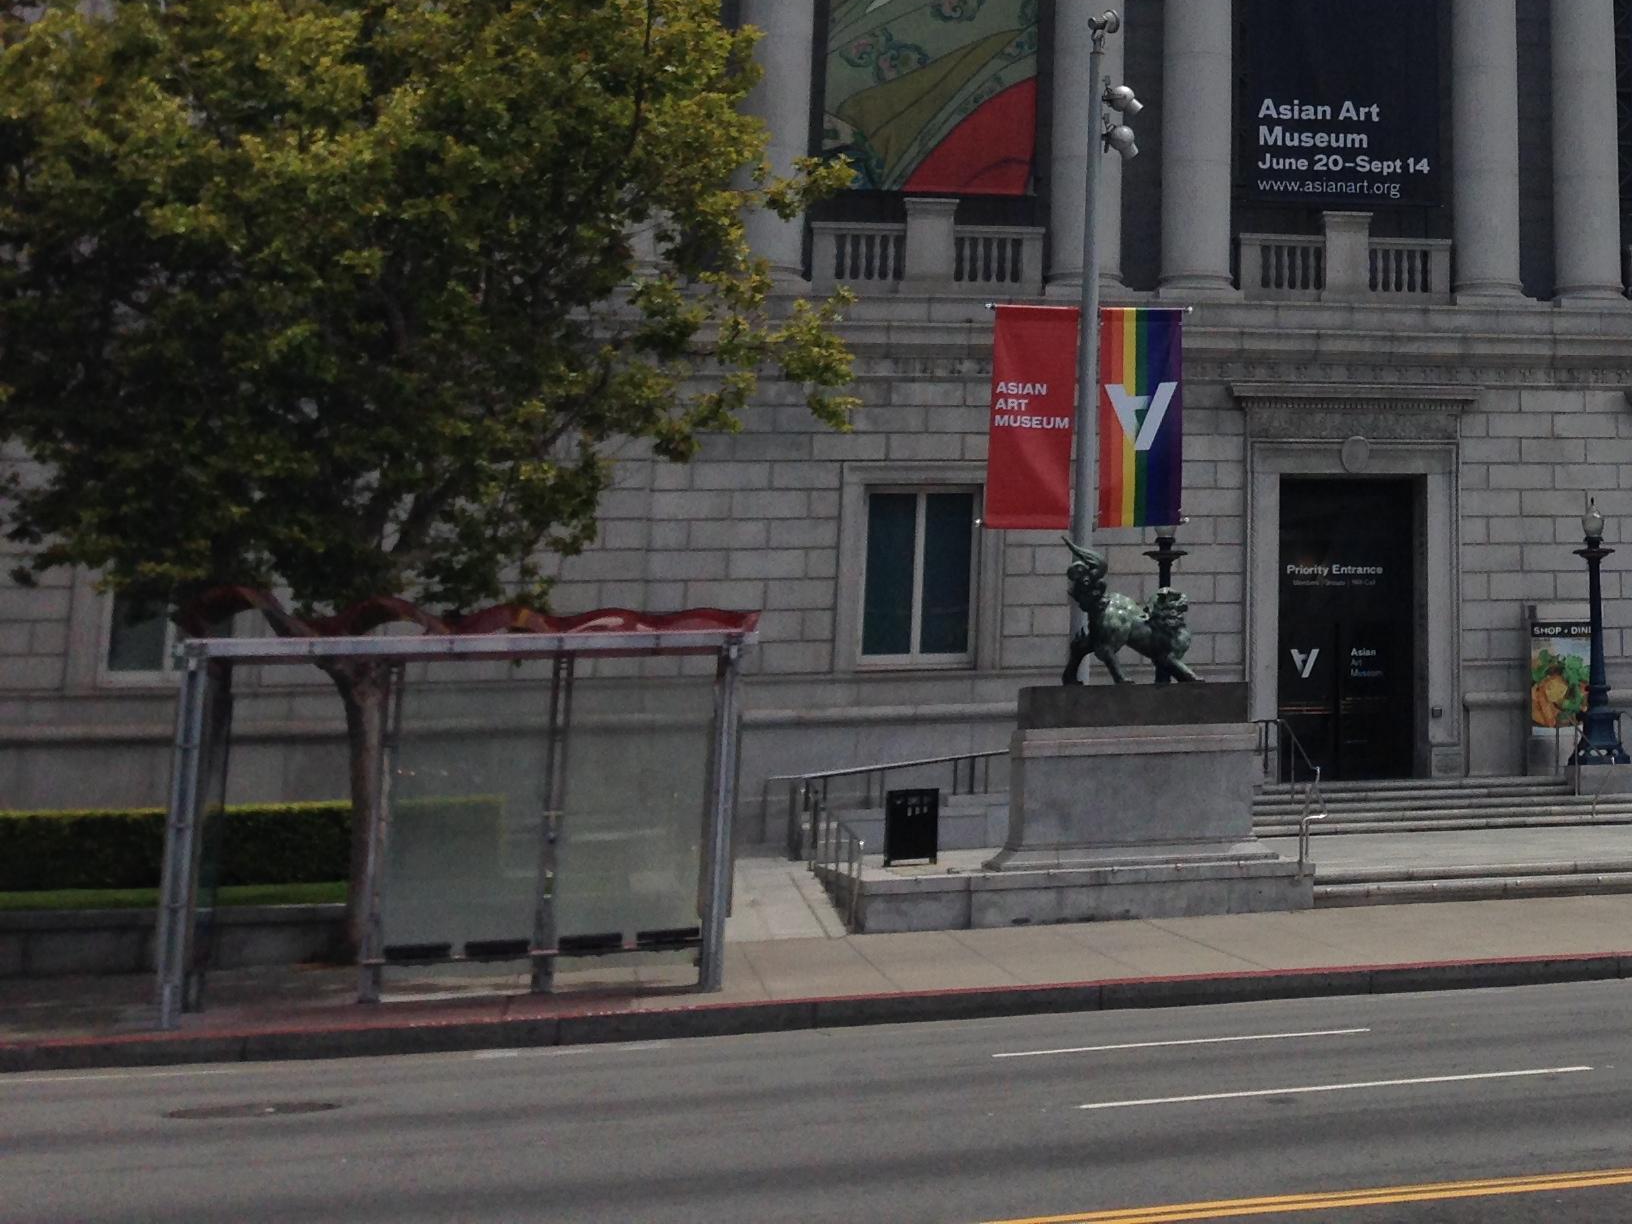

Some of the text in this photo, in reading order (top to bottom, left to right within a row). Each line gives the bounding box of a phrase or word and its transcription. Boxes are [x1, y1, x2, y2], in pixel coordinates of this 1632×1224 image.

[1257, 98, 1380, 122] Asian Art
[1258, 125, 1369, 149] Museum
[1257, 152, 1309, 171] June
[1407, 158, 1430, 174] 14
[1257, 178, 1401, 199] www.asianart.org
[996, 382, 1047, 396] ASIAN
[995, 398, 1029, 411] ART
[994, 415, 1069, 430] MUSEUM
[1286, 564, 1383, 576] Priority Entrance
[1533, 626, 1562, 635] SHOP
